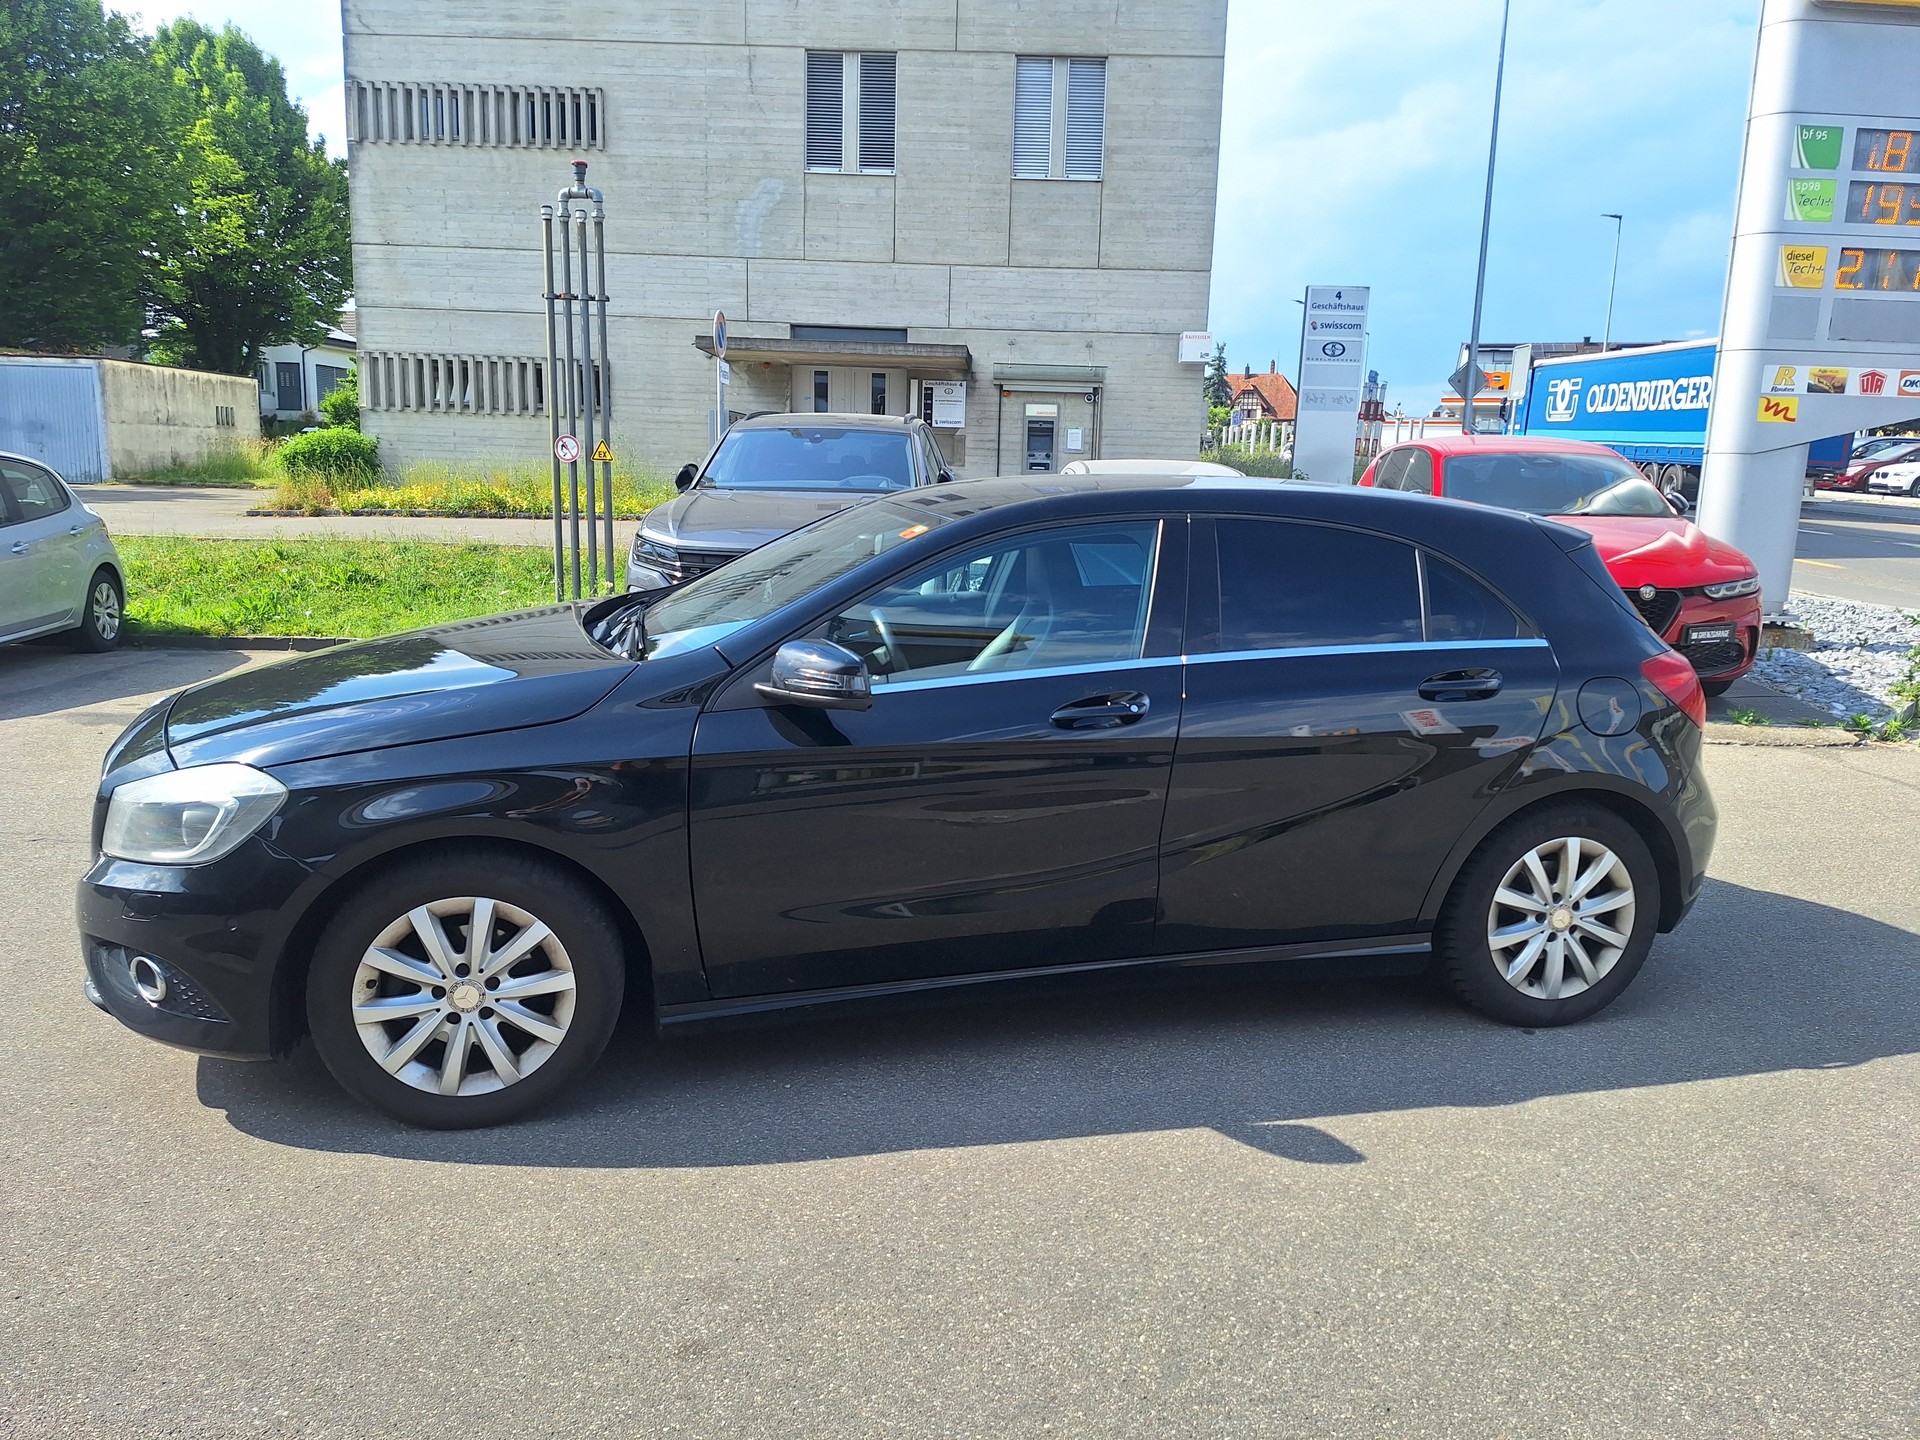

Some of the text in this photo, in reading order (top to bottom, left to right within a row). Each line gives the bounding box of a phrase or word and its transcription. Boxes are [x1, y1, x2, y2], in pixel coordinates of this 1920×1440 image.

[1802, 128, 1828, 140] bf 95
[1795, 182, 1821, 192] sp98
[1798, 194, 1834, 207] Tech+
[1786, 250, 1815, 261] diesel
[1789, 262, 1825, 274] Tech+
[1335, 291, 1342, 300] 4
[1311, 302, 1364, 311] Geschäftshaus
[1320, 320, 1362, 330] swisscom
[1861, 374, 1885, 394] UTA
[1586, 375, 1713, 413] OLDENBURGER
